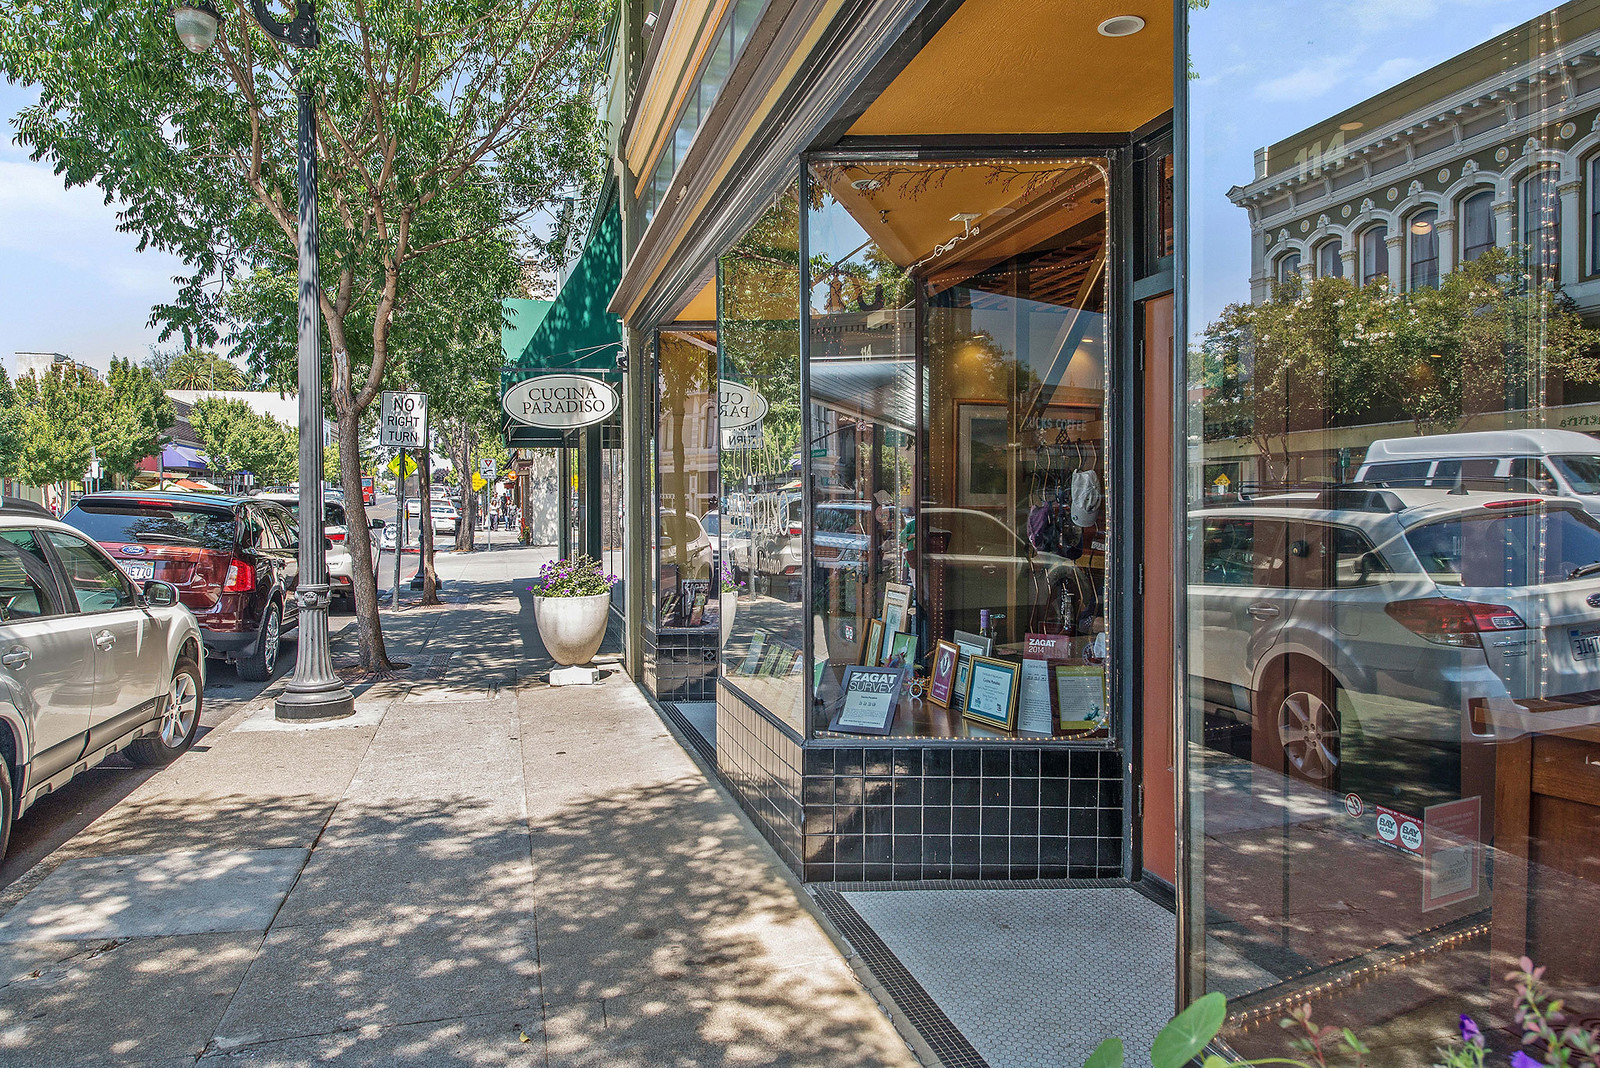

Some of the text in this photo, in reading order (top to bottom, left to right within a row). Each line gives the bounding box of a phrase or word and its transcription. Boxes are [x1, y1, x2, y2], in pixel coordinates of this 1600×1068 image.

[1293, 130, 1345, 185] 114
[528, 387, 597, 401] CUCINA
[393, 397, 415, 412] NO
[522, 400, 605, 415] PARADISO
[387, 415, 420, 428] RIGHT
[1055, 418, 1087, 431] COFFEE
[388, 430, 418, 443] TURN
[733, 431, 783, 480] CUCINA
[1028, 638, 1056, 648] ZAGAT
[1028, 645, 1046, 654] 2014
[851, 672, 898, 684] ZAGAT
[848, 681, 895, 693] SURVEY
[1379, 817, 1396, 829] BAY
[1379, 826, 1396, 836] ALARM
[1402, 825, 1420, 838] BAY
[1402, 835, 1419, 844] ALARM
